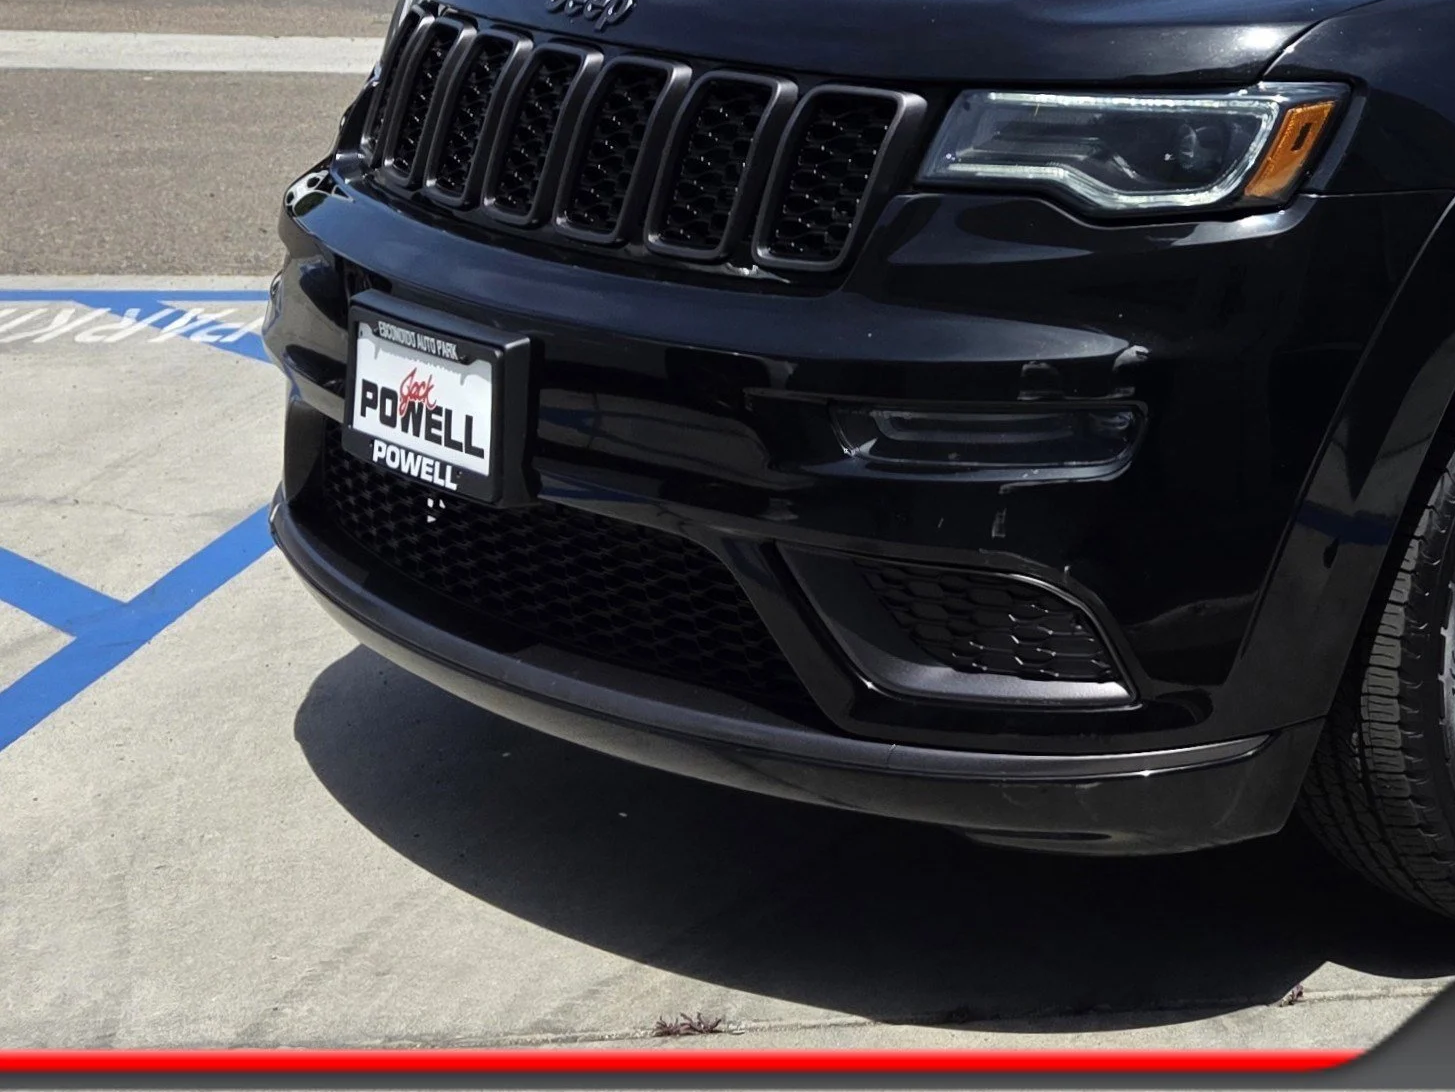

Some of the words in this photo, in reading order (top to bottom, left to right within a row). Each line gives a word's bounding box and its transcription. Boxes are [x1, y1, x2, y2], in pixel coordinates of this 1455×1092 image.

[378, 320, 417, 349] ESCONDIDO
[416, 333, 436, 355] AUTO
[436, 339, 460, 362] PARK
[398, 366, 438, 418] Jack
[361, 379, 484, 459] POWELL
[371, 438, 459, 491] POWELL
